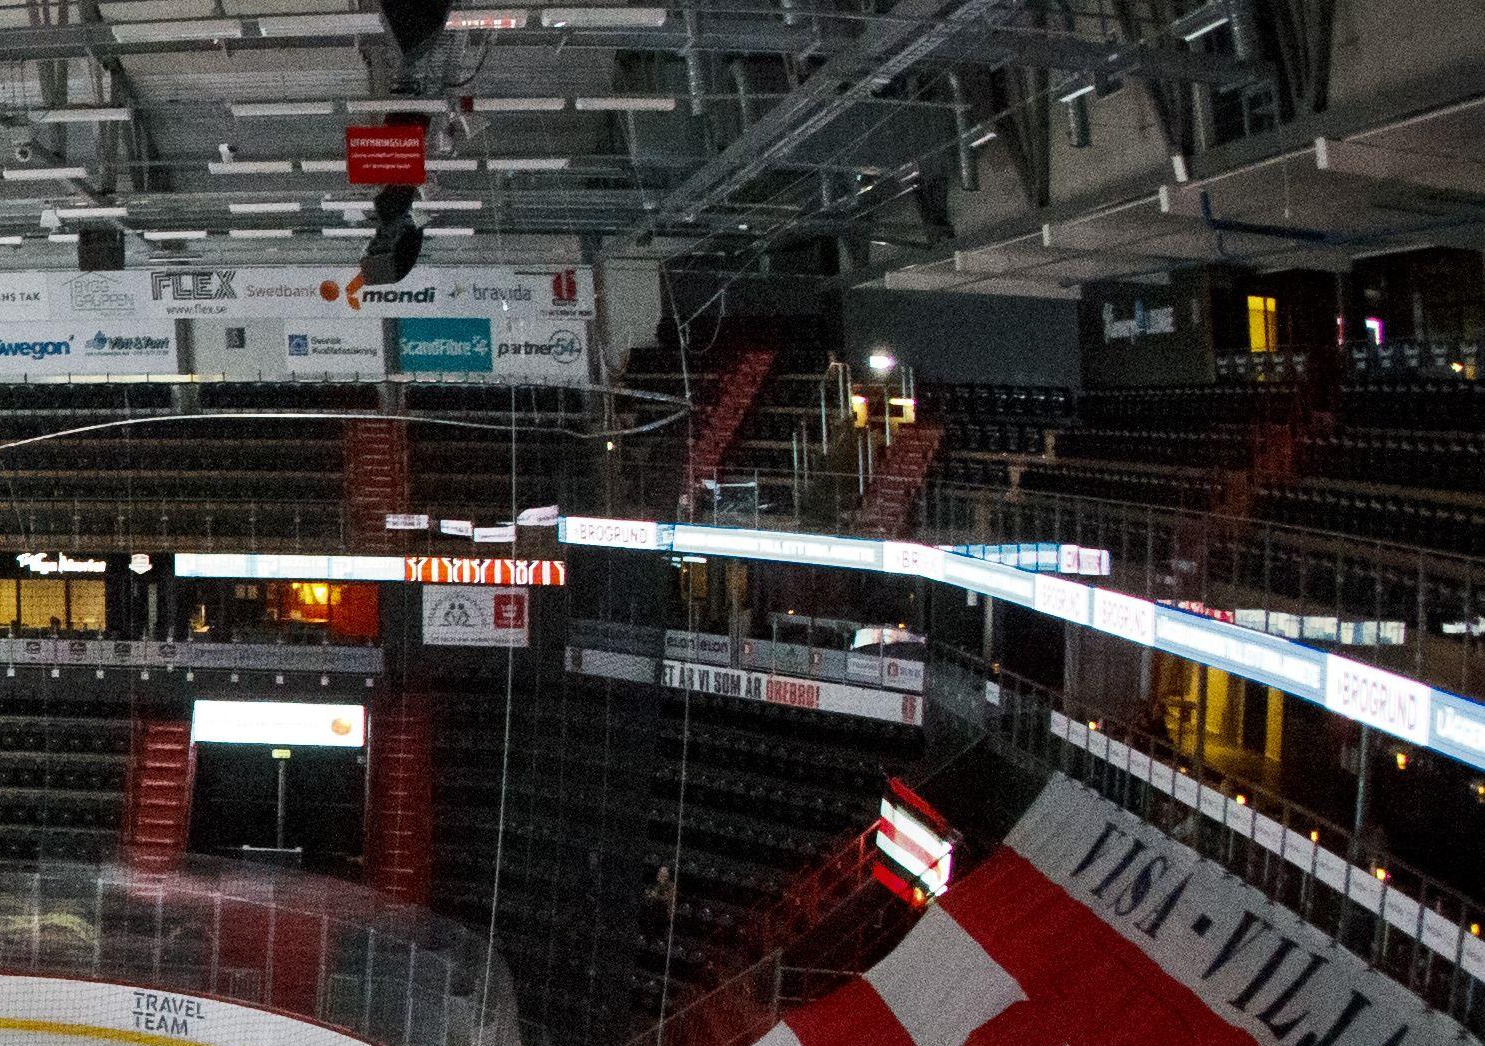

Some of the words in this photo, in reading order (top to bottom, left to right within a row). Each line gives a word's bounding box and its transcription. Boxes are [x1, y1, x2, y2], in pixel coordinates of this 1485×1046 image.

[19, 292, 41, 301] TAK
[151, 271, 237, 300] FLEX
[246, 283, 316, 298] Swedbank
[362, 287, 436, 303] mondi
[472, 284, 532, 300] bravida
[580, 523, 648, 544] BROGRUND
[699, 640, 729, 653] elon
[679, 664, 694, 690] ÄR
[699, 668, 710, 689] VI
[714, 672, 741, 693] SOM
[745, 674, 762, 699] ÄR
[766, 680, 820, 709] ÖREBRO!
[1341, 669, 1419, 733] BROGRUND
[1073, 820, 1195, 942] VISA
[133, 991, 205, 1020] TRAVEL
[131, 1010, 188, 1036] TEAM
